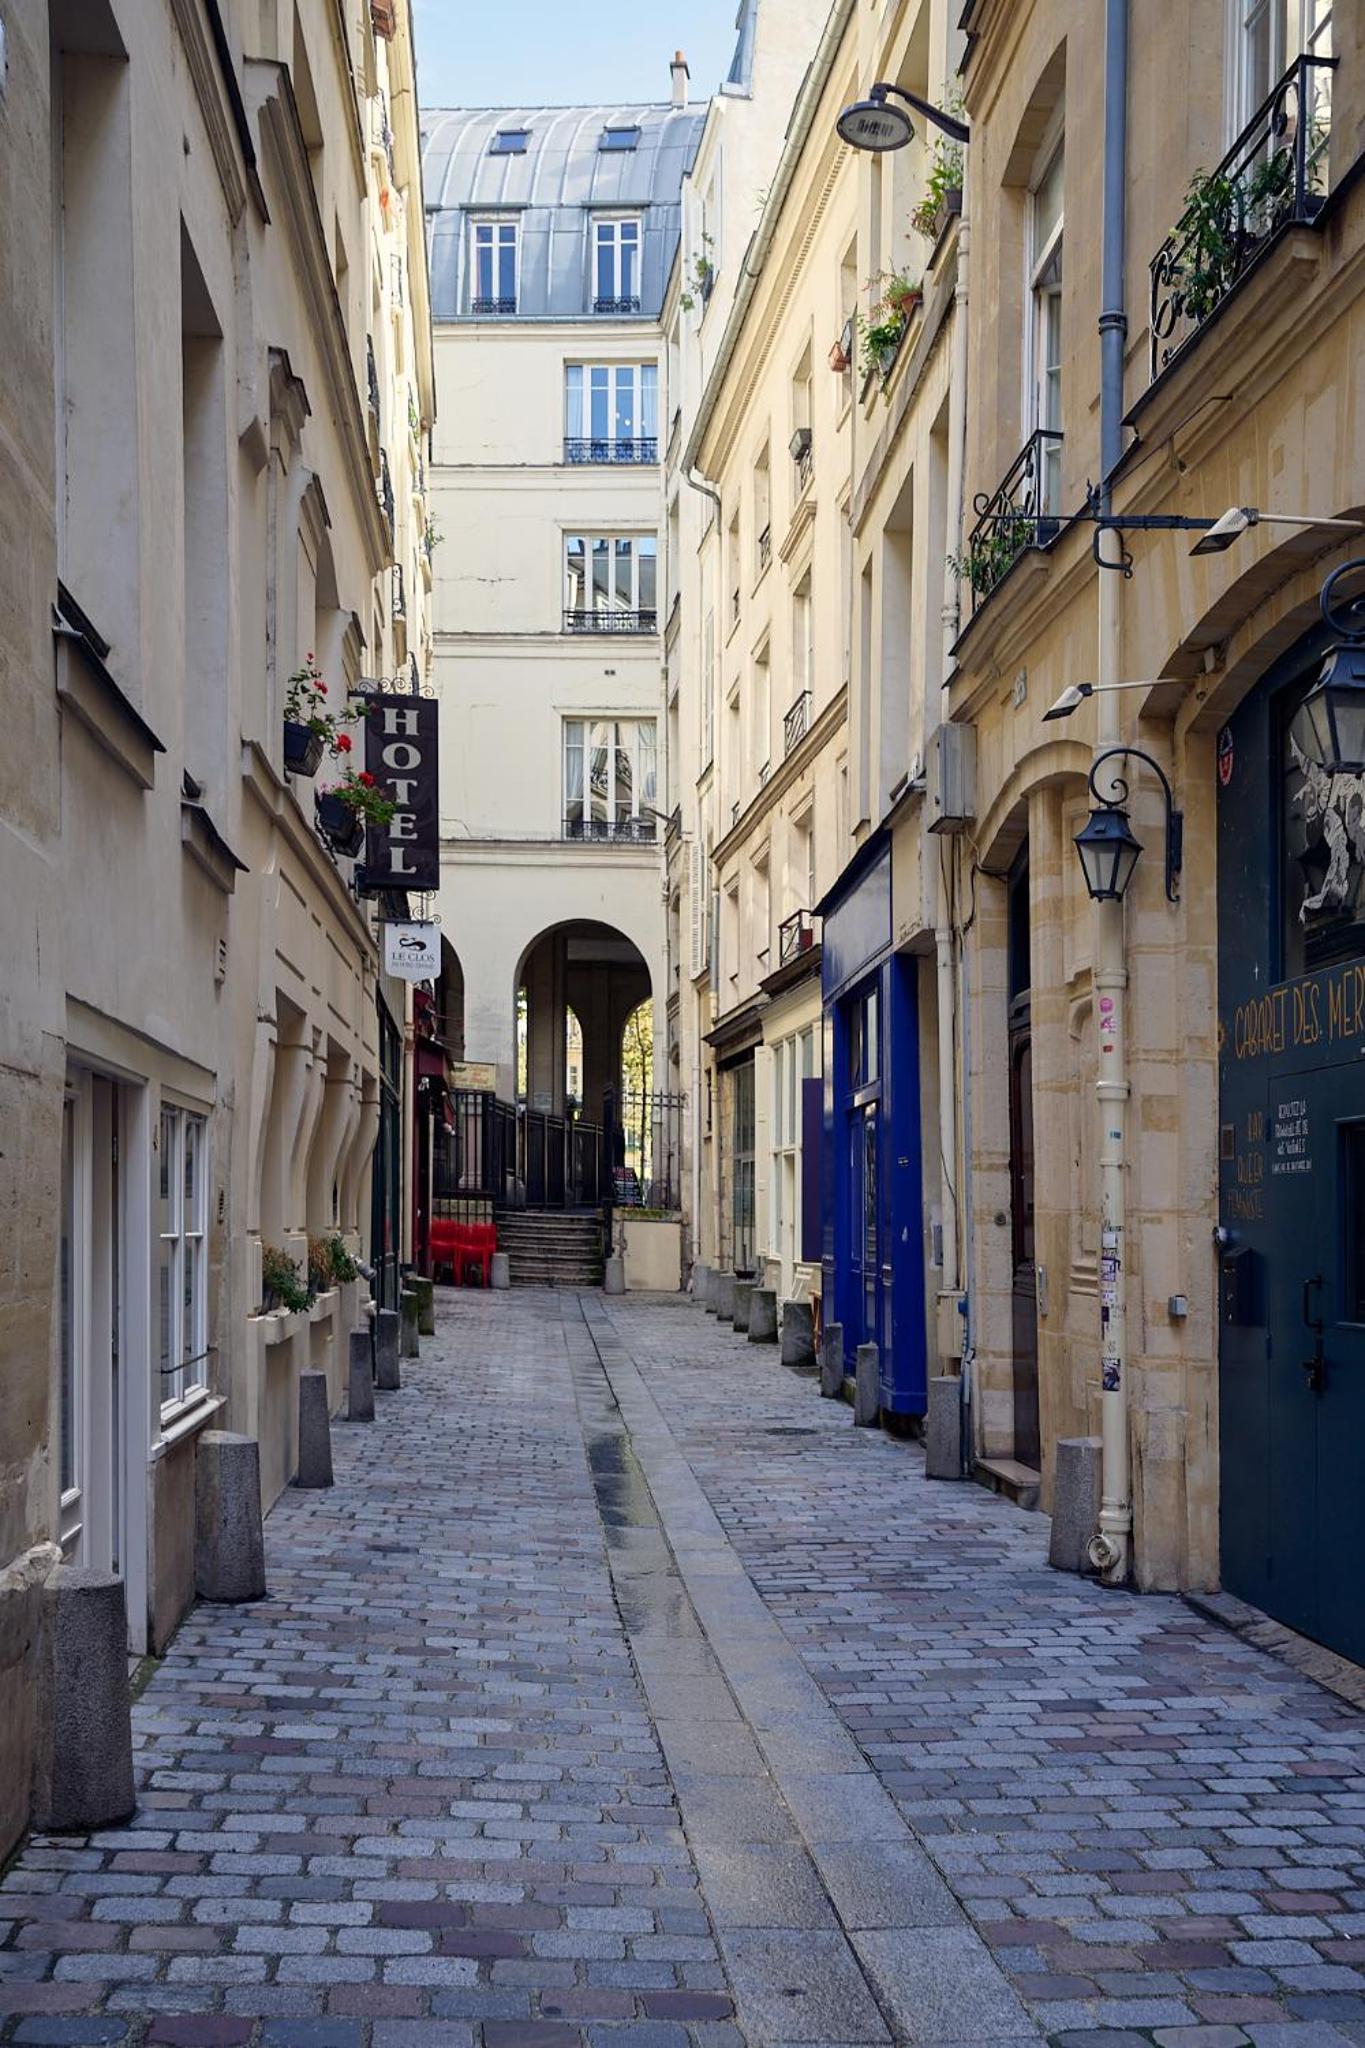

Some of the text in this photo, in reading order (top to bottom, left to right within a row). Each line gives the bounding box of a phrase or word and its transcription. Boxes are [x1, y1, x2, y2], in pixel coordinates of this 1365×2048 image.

[382, 708, 422, 875] HOTEL
[392, 952, 435, 963] LE CLOS
[1235, 966, 1365, 1060] CABARET DES MER
